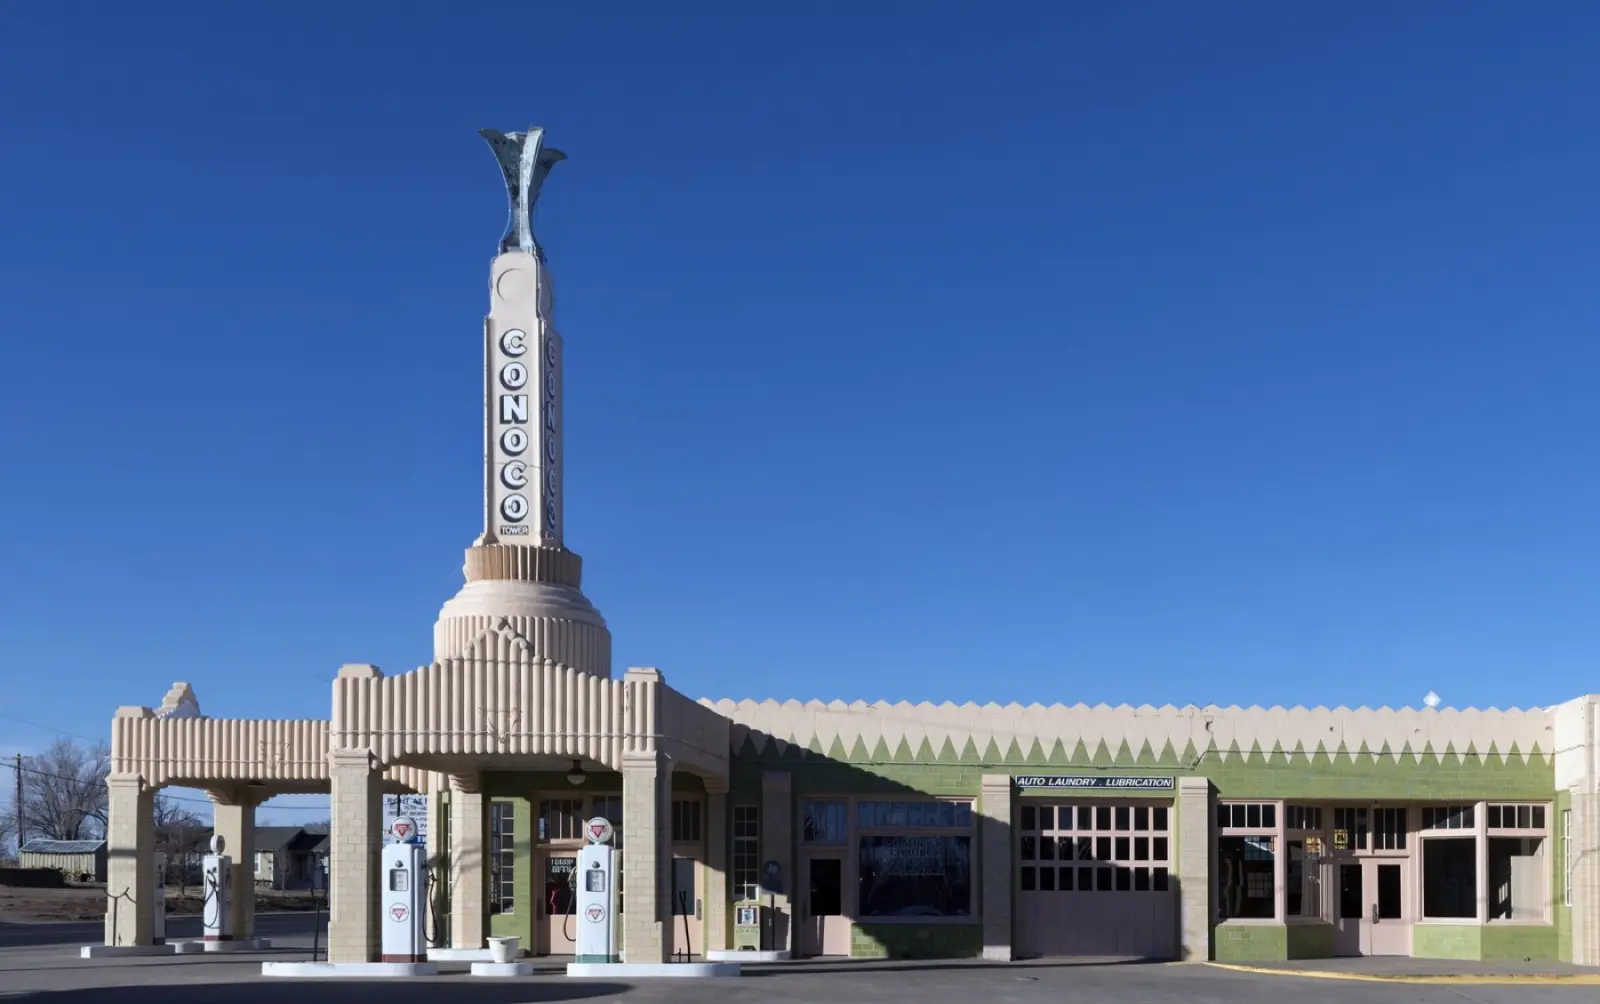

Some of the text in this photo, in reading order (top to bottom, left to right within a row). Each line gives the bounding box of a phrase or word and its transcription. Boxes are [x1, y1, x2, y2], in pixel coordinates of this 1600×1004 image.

[499, 328, 529, 523] CONOCO
[546, 337, 557, 531] CONOCO
[502, 527, 528, 535] TOWER
[1017, 777, 1171, 787] AUTO LAUNDRY LUBRICATION
